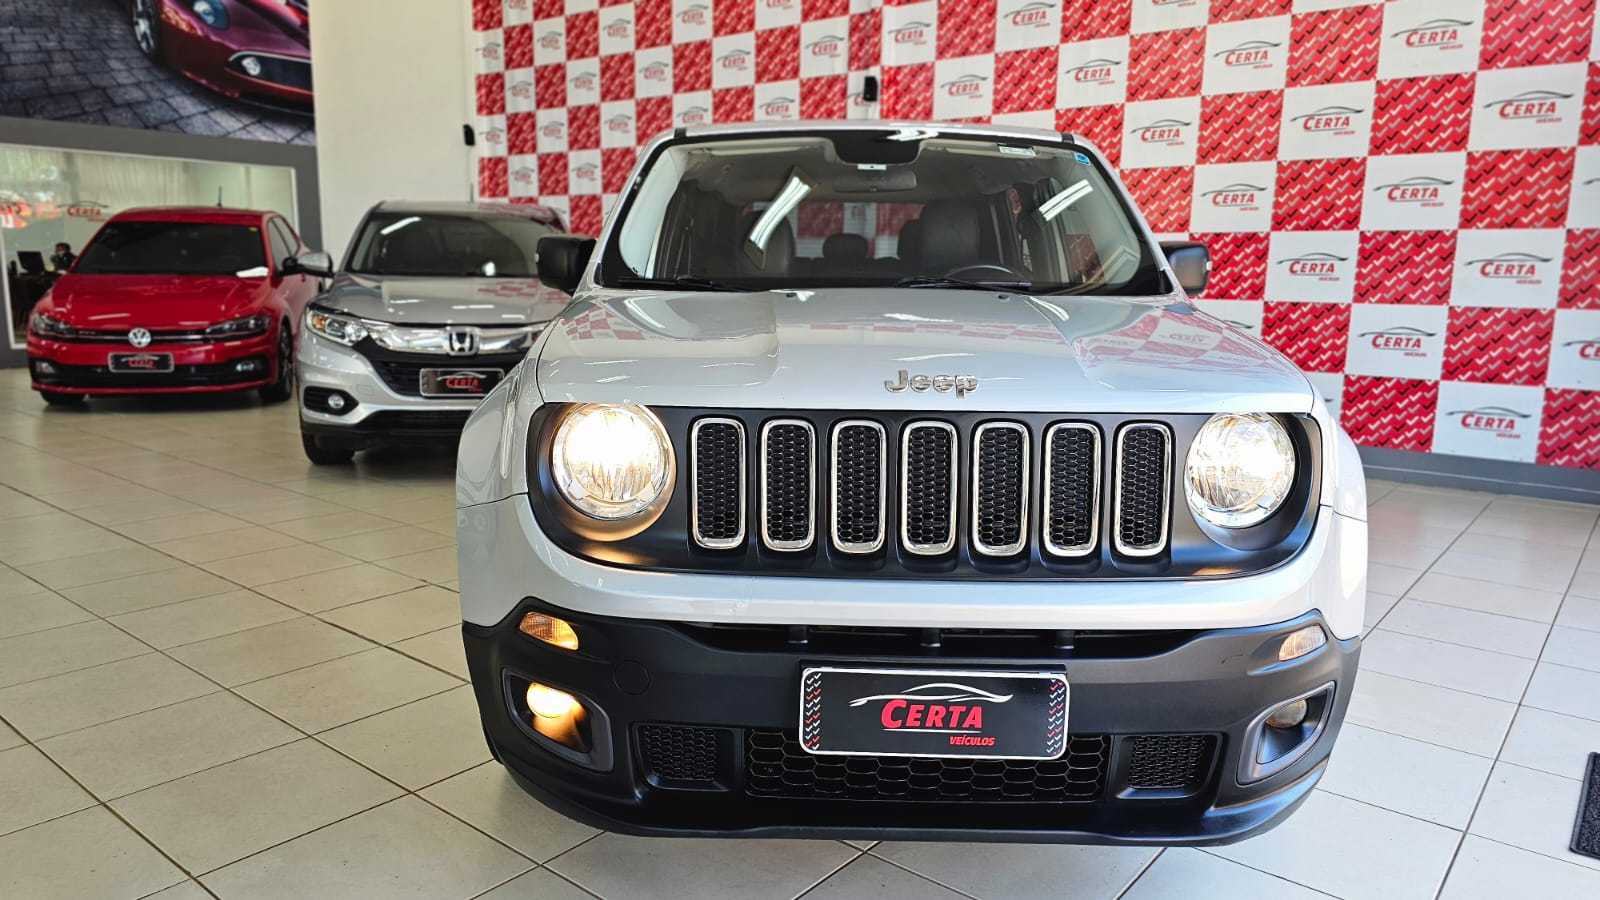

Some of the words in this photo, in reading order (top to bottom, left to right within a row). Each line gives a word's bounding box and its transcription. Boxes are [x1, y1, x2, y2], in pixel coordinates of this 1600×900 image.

[1012, 10, 1047, 26] CERTA
[1406, 29, 1457, 48] CERTA
[1224, 50, 1269, 66] CERTA
[1074, 67, 1112, 82] CERTA
[948, 82, 980, 95] CERTA
[1499, 100, 1556, 118] CERTA
[1303, 115, 1351, 131] CERTA
[1140, 128, 1181, 142] CERTA
[1212, 192, 1255, 206] CERTA
[1387, 186, 1439, 202] CERTA
[1289, 260, 1336, 275] CERTA
[1479, 261, 1537, 278] CERTA
[1371, 333, 1422, 350] CERTA
[884, 369, 977, 399] Jeep
[1461, 412, 1515, 430] CERTA
[881, 698, 982, 729] CERTA
[949, 735, 996, 747] VEÍCULOS
